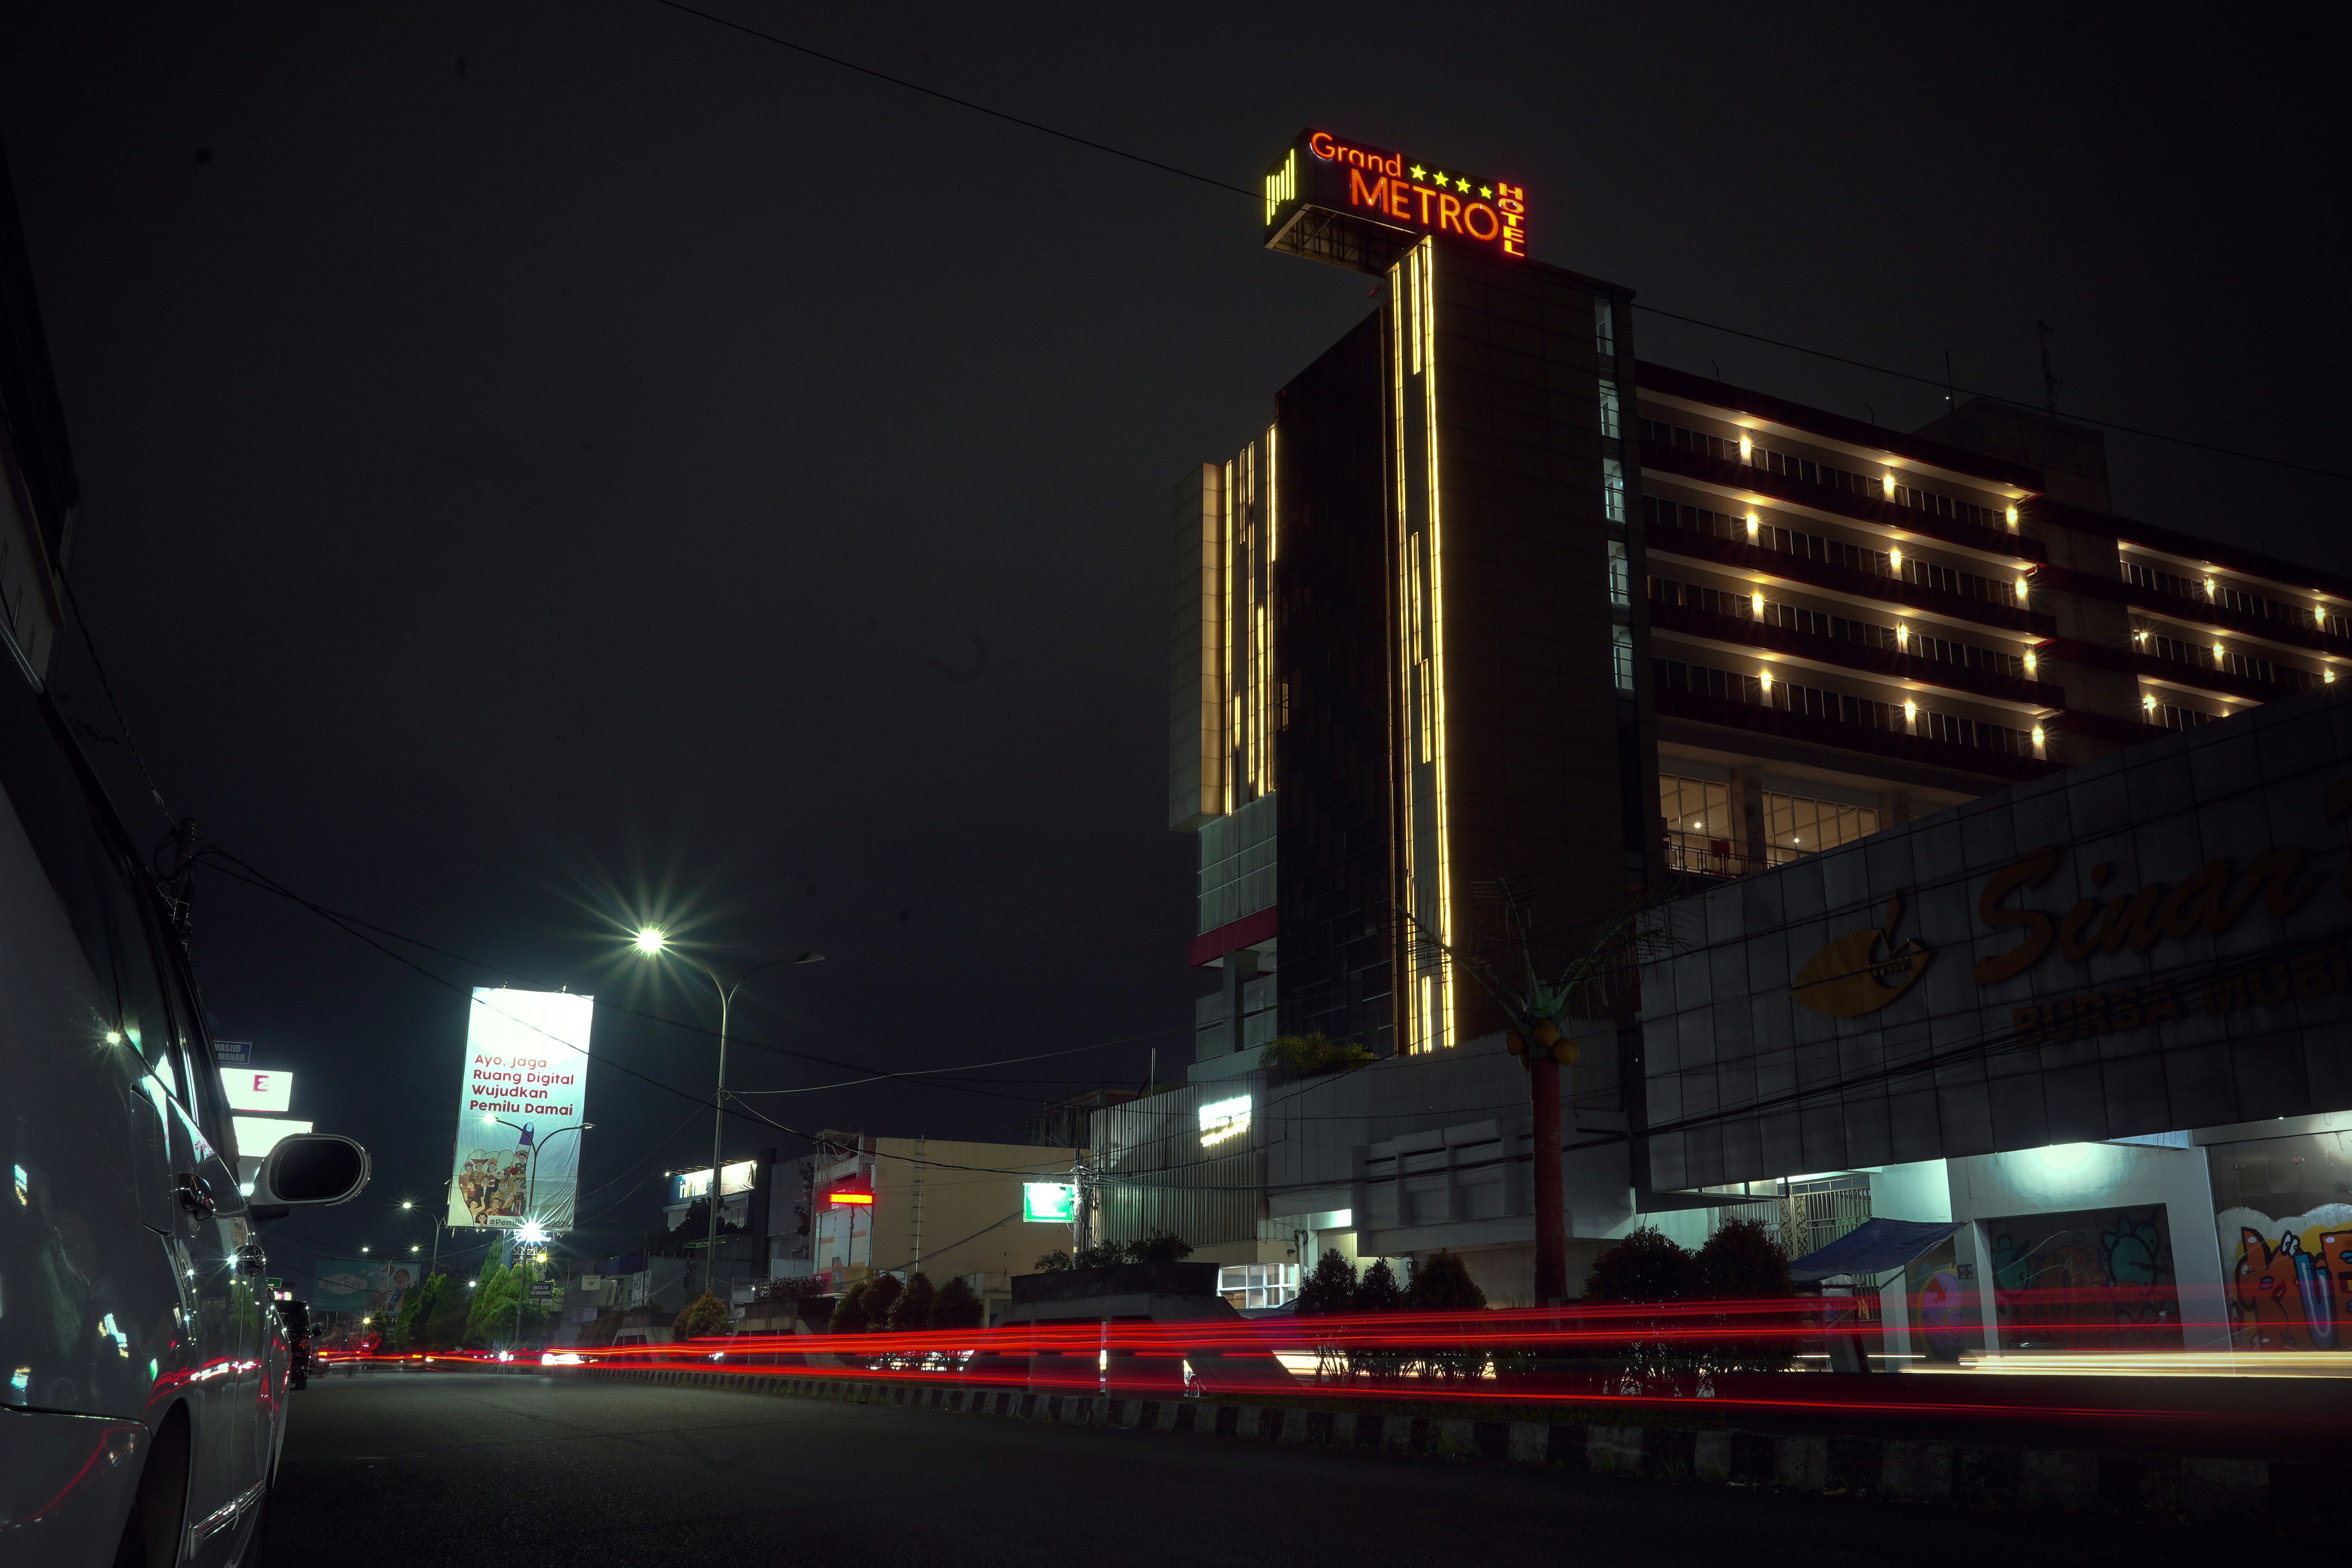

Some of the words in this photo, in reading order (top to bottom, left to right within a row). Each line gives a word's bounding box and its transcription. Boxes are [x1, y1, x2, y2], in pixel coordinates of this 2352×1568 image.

[1310, 132, 1402, 178] Grand
[1351, 169, 1499, 241] METRO
[1498, 182, 1525, 256] HOTEL
[1973, 846, 2317, 985] Sinar
[2013, 980, 2183, 1047] BURSA
[2203, 943, 2352, 1015] MOBI
[473, 1069, 521, 1084] Ruang
[527, 1071, 574, 1086] Digital
[474, 1054, 506, 1067] Ayo,
[470, 1100, 520, 1113] Pemilu
[524, 1103, 573, 1116] Damai
[472, 1085, 548, 1099] Wujudkan
